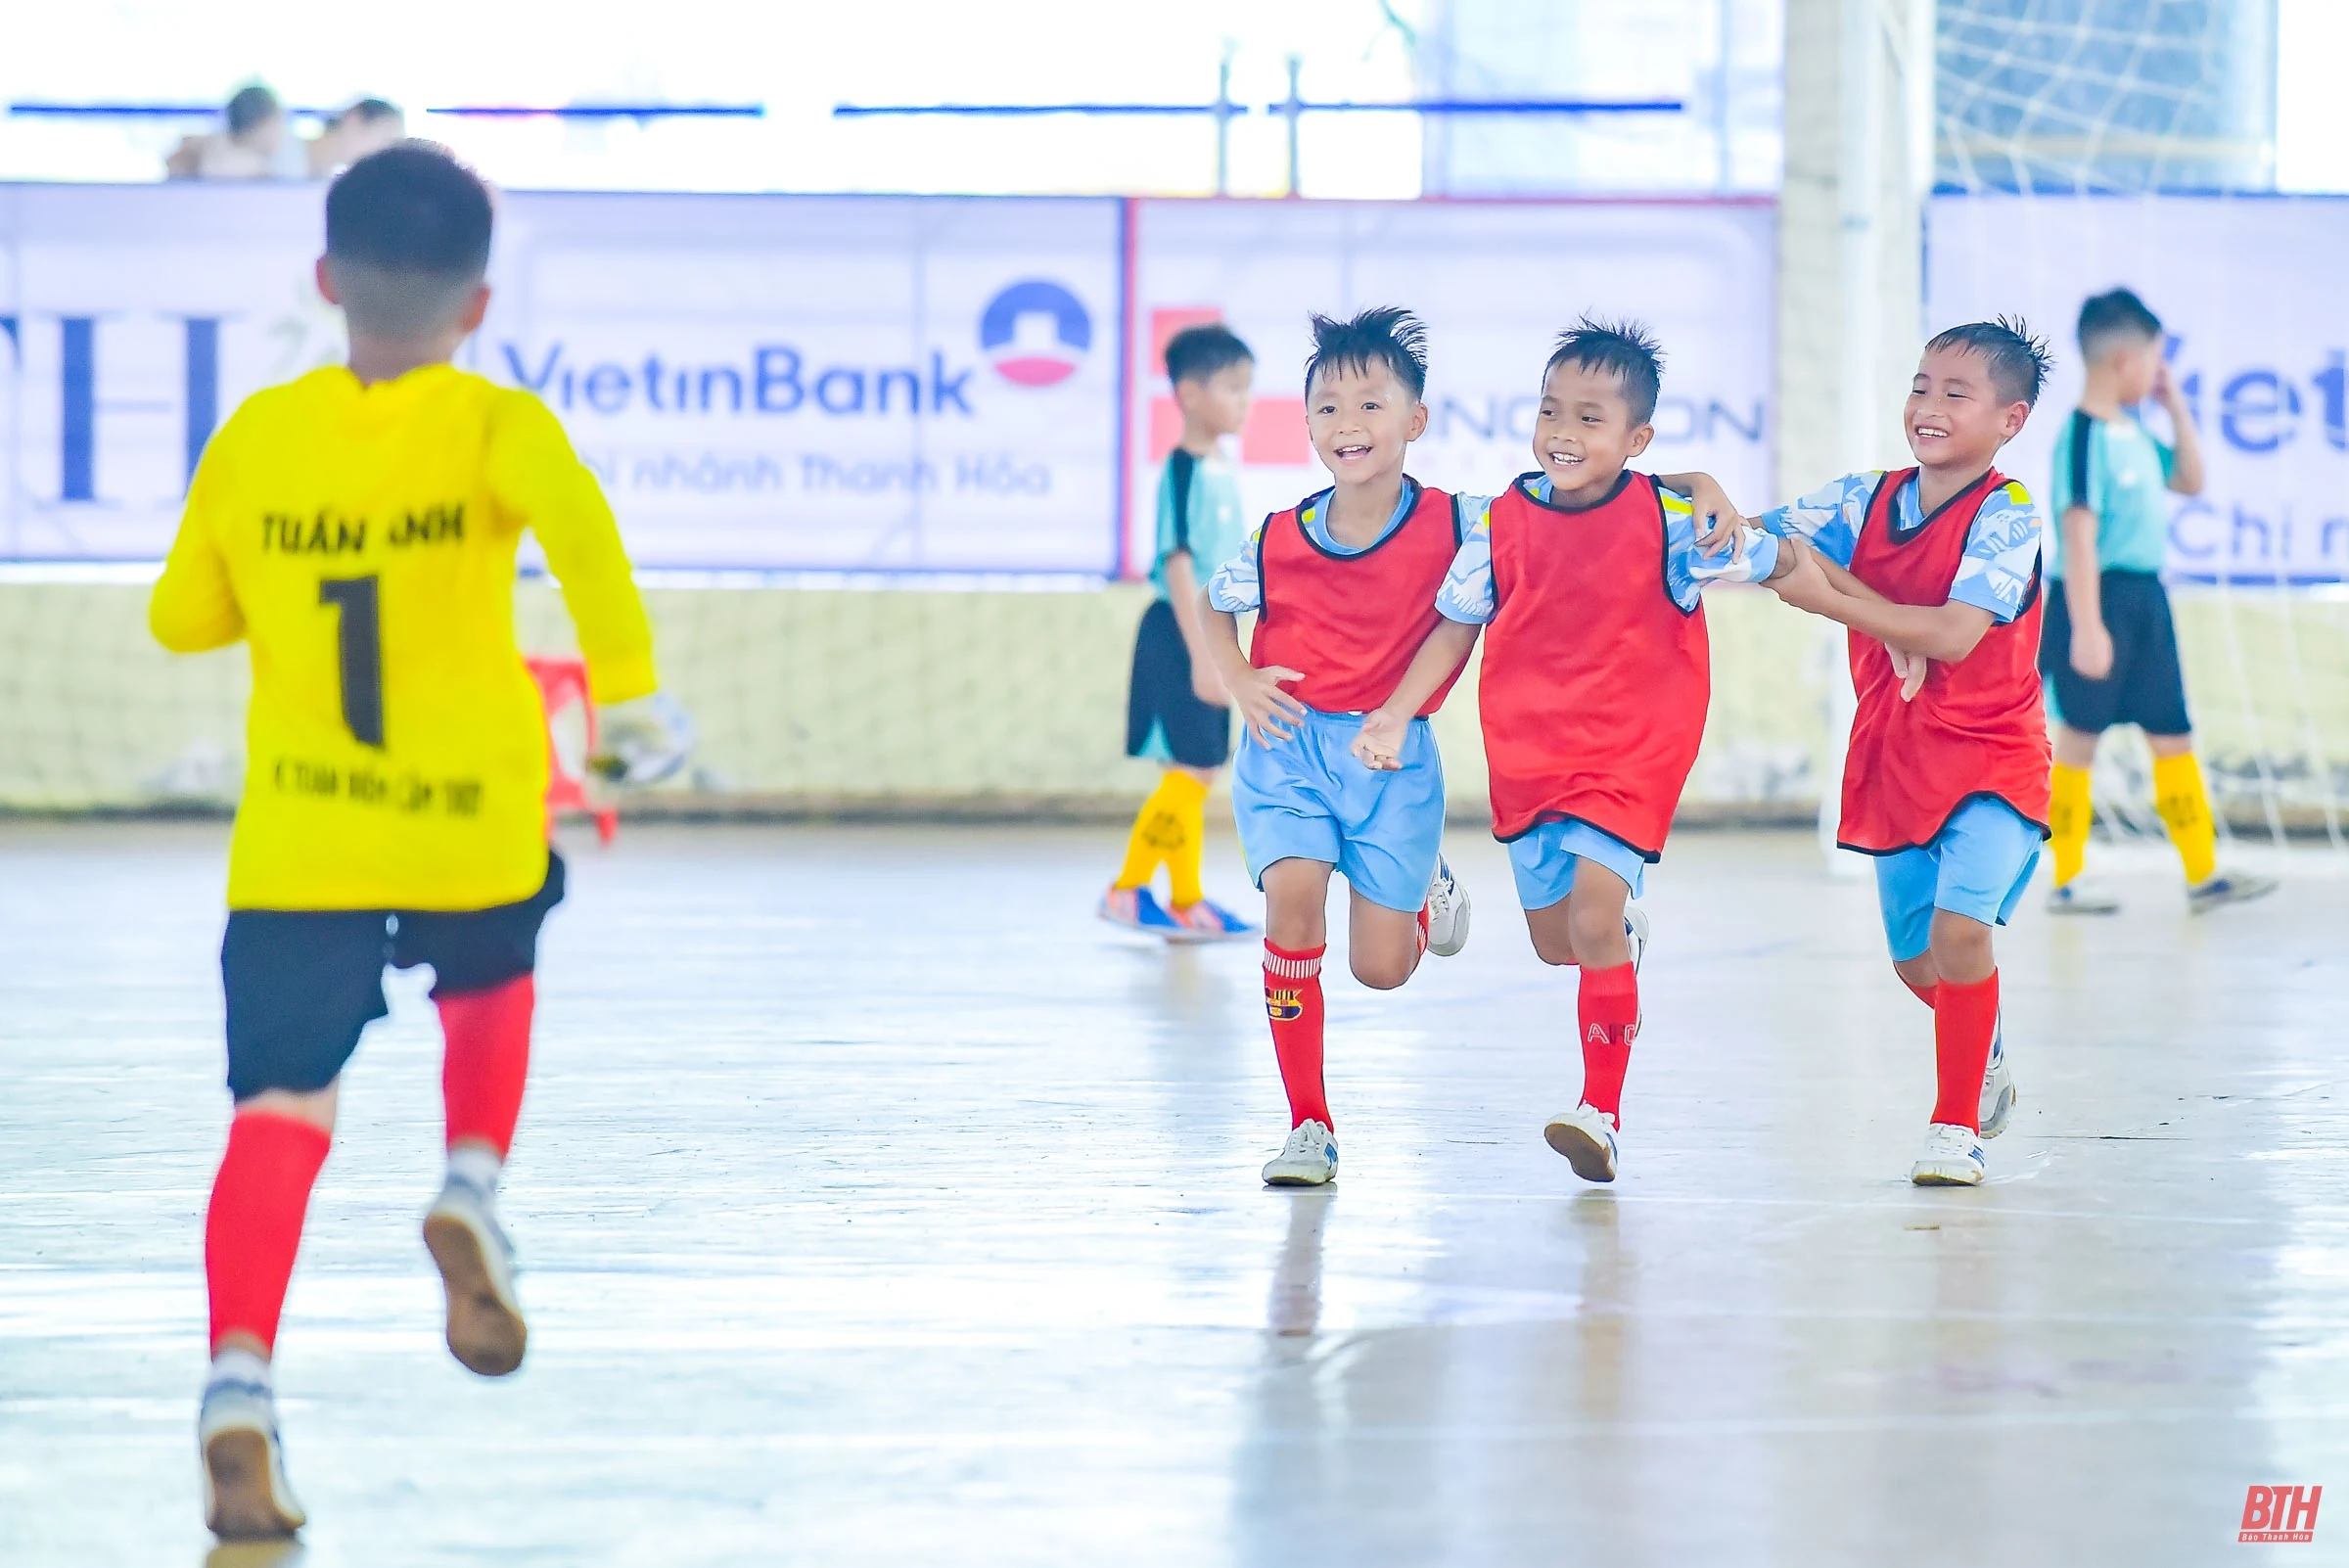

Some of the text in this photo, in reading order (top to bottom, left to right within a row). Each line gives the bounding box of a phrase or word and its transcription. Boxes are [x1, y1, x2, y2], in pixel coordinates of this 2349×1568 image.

[501, 341, 975, 414] VietinBank
[2167, 497, 2292, 562] Chi
[319, 574, 384, 750] 1
